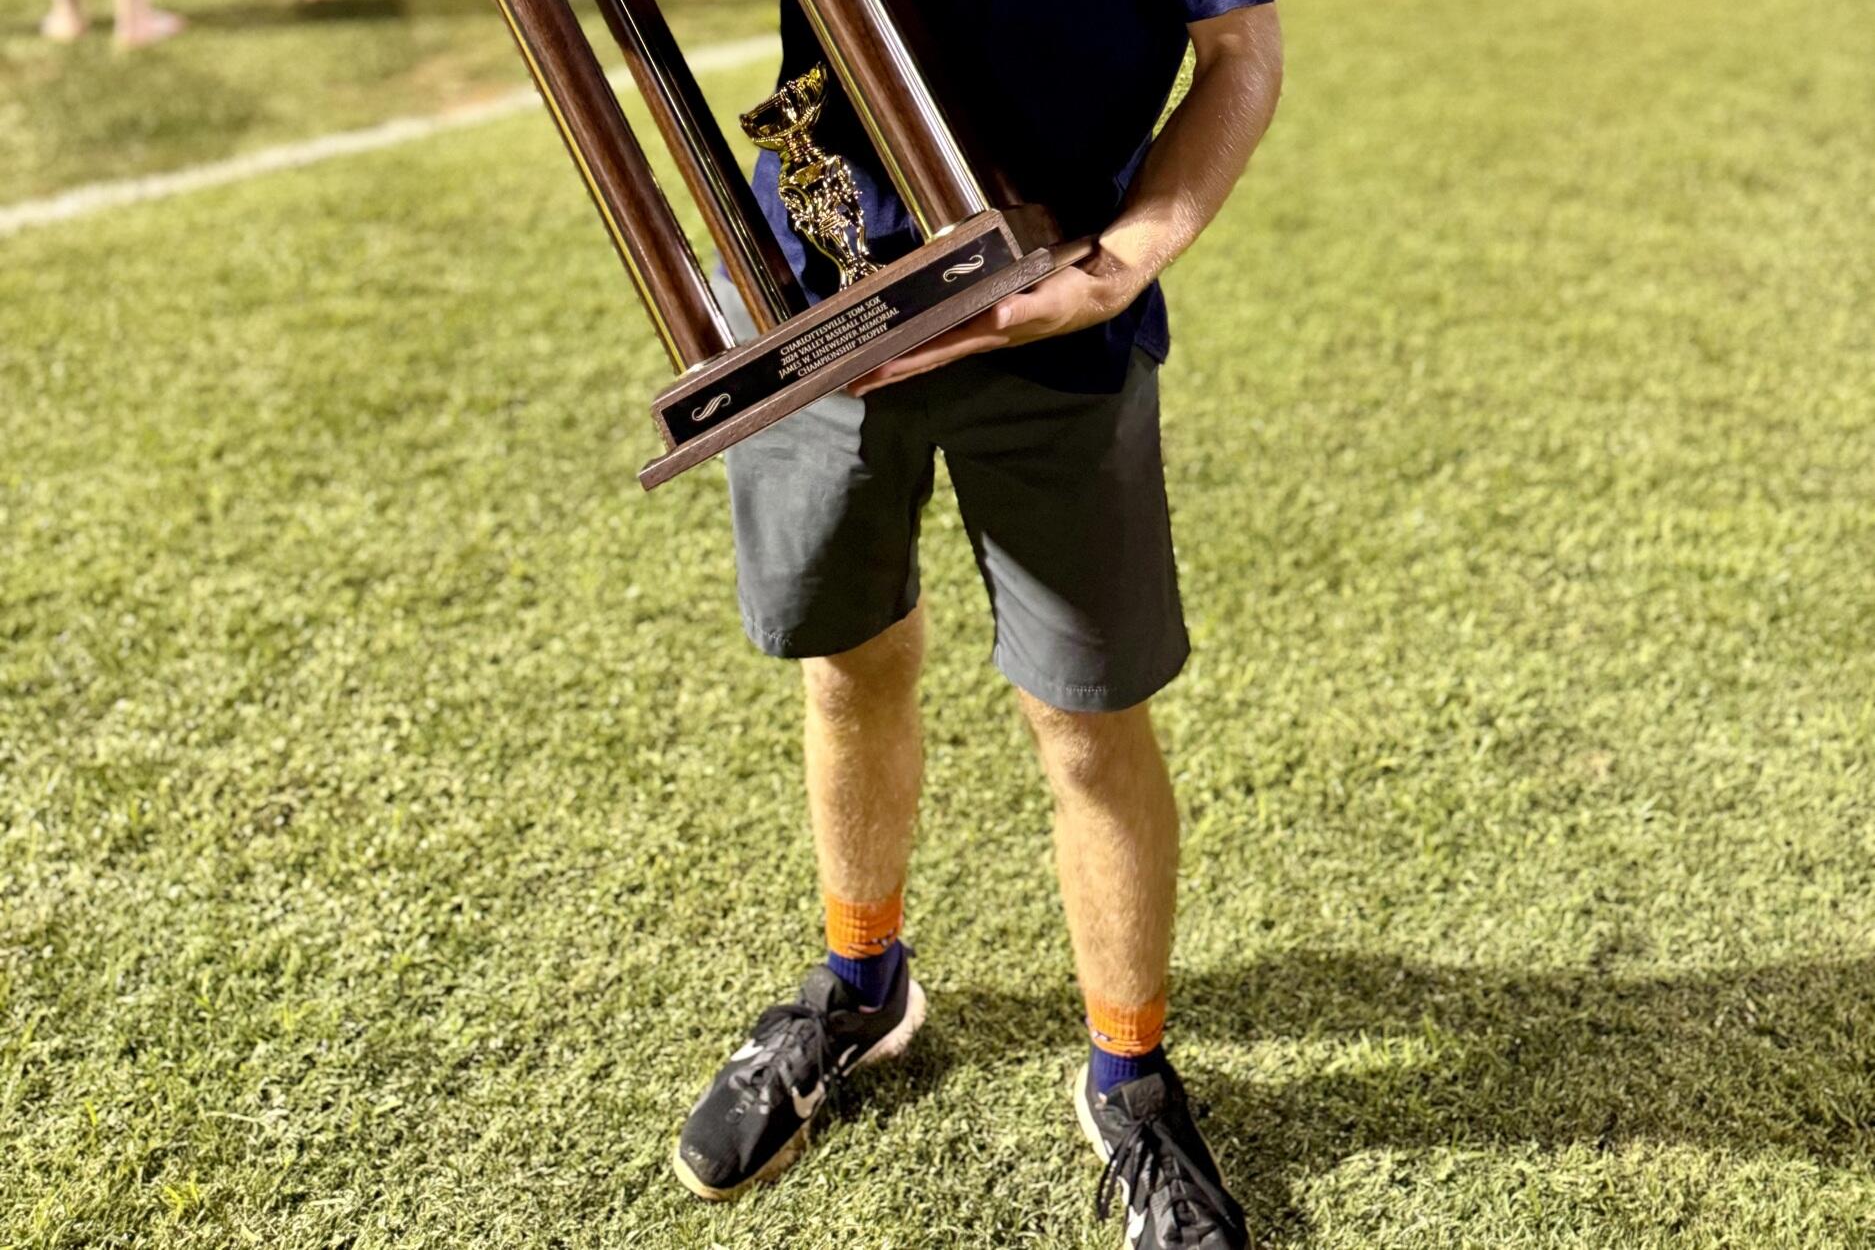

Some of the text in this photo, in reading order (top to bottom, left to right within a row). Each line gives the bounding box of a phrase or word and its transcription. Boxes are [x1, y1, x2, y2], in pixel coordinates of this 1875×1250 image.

[778, 361, 802, 380] JAMES
[812, 328, 860, 359] LINEWEAVER
[859, 307, 900, 334] MEMORIAL
[780, 296, 882, 356] CHARLOTTESVILLE TOM SOX
[781, 302, 889, 366] 2024 VALLEY BASEBALL LEAGUE
[797, 322, 889, 377] CHAMPIONSHIP TROPHY
